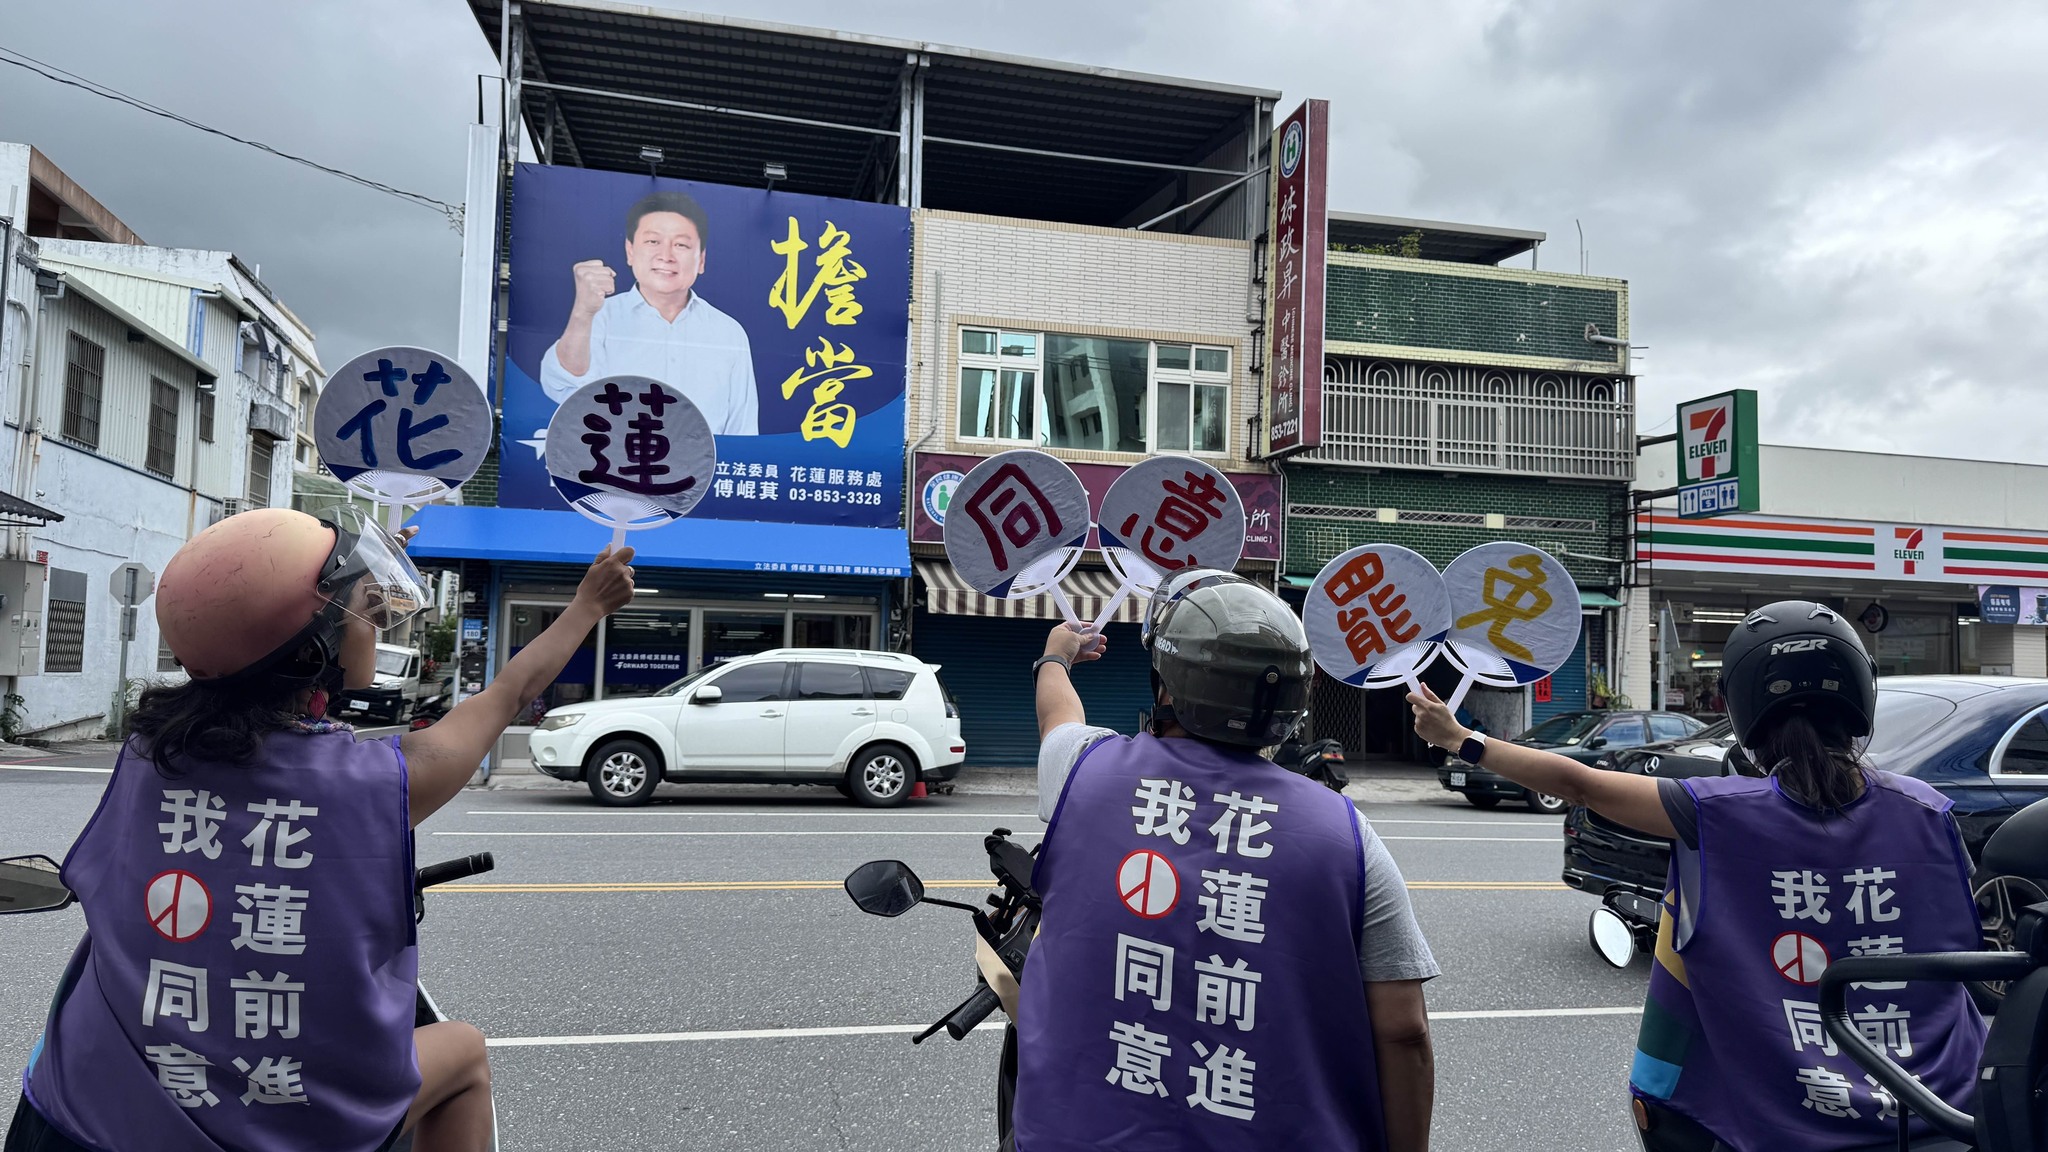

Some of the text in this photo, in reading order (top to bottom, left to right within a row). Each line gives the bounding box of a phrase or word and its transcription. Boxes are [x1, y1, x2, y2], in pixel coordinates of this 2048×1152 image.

[769, 217, 873, 449] 擔當
[336, 358, 463, 470] 花
[579, 382, 697, 496] 蓮
[1270, 417, 1298, 441] 853-7221
[713, 479, 882, 506] 傅崐萁 03-853-3328
[715, 461, 883, 488] 立法委員 花蓮服務處
[966, 463, 1062, 571] 同
[1701, 487, 1716, 498] ATM
[754, 562, 787, 571] 立法委員
[1120, 470, 1227, 589] 意
[1245, 535, 1268, 543] CLINIC
[1323, 552, 1421, 665] 罷
[1456, 553, 1553, 662] 免
[156, 788, 227, 860] 我
[1104, 776, 1197, 1099] 我 同意
[1770, 870, 1832, 925] 我
[229, 798, 319, 1108] 花蓮前進
[1184, 787, 1280, 1122] 花蓮前進
